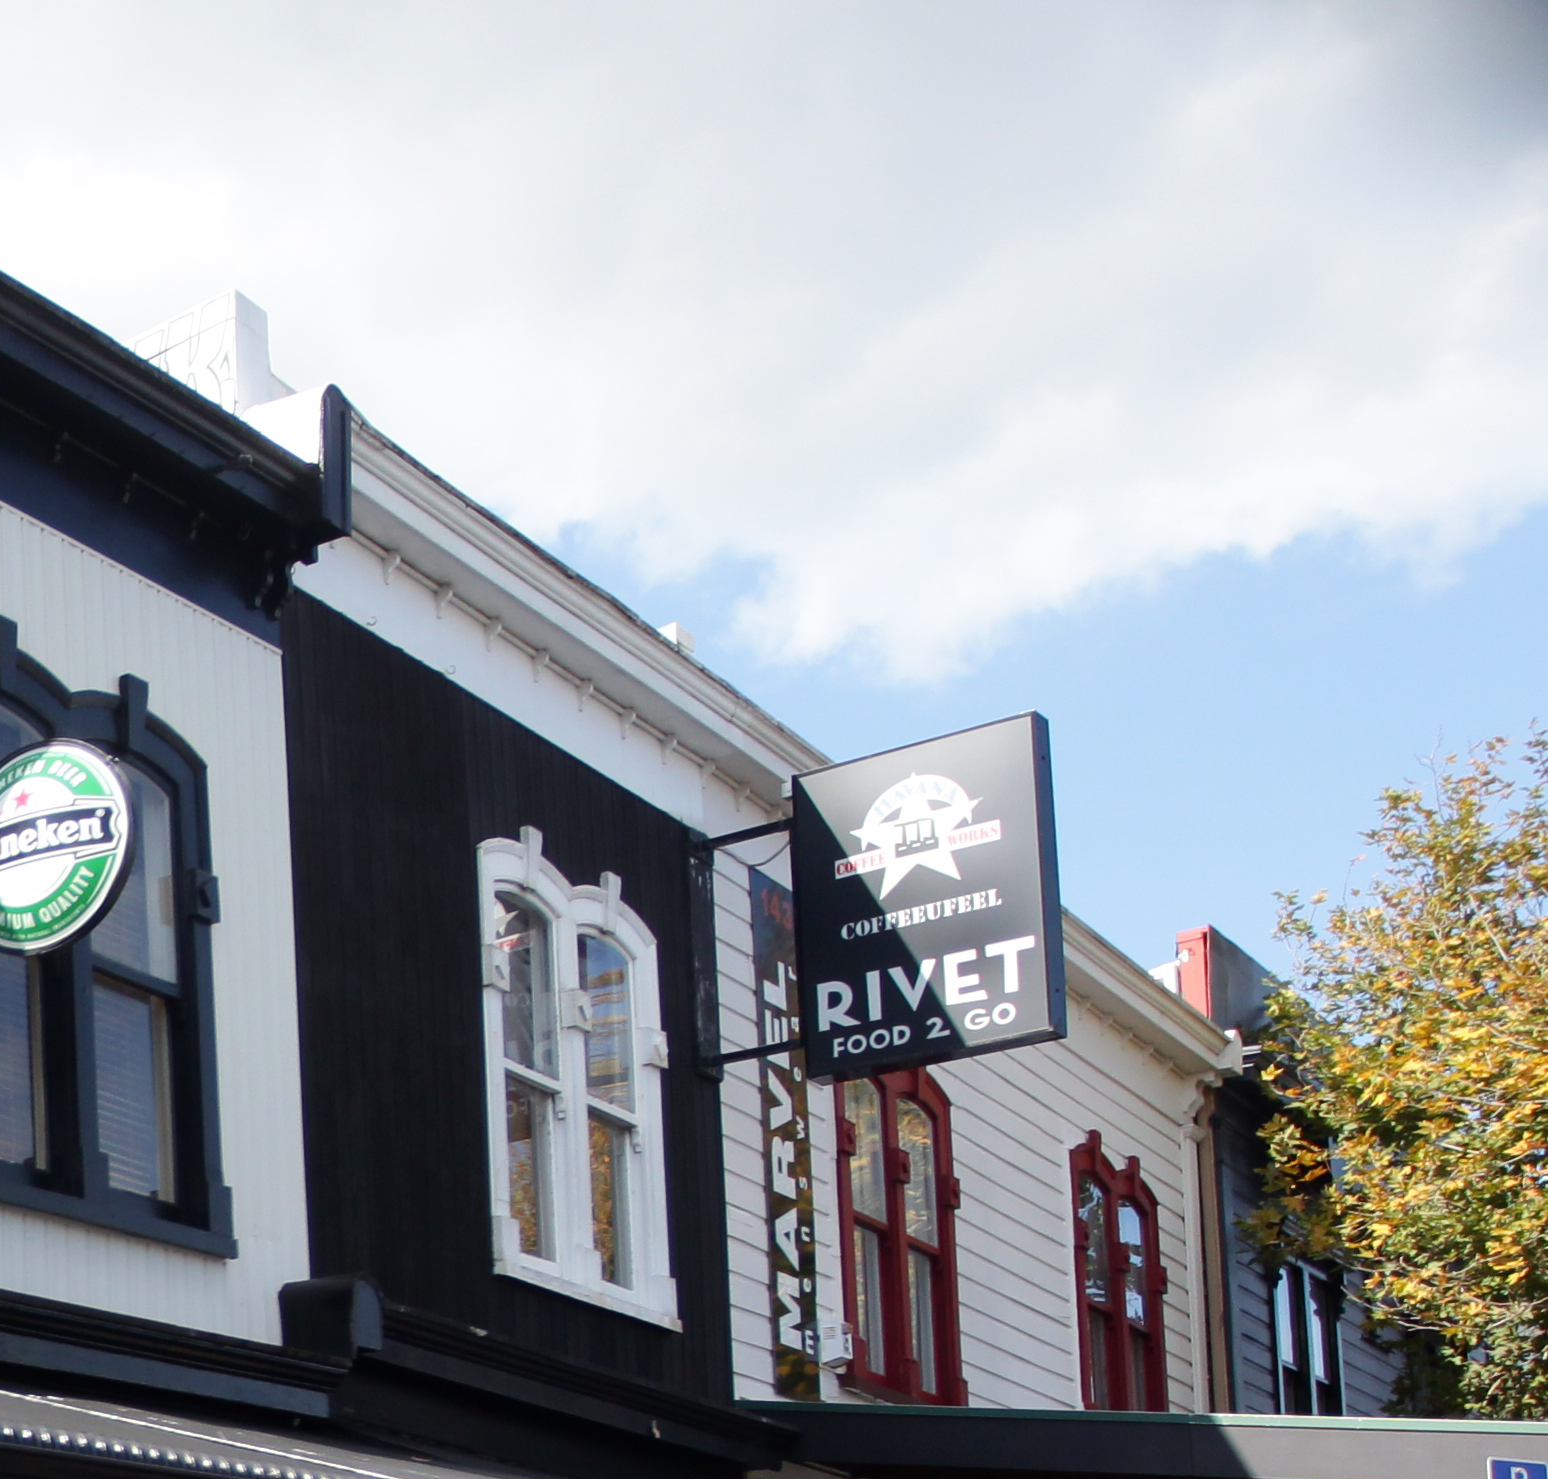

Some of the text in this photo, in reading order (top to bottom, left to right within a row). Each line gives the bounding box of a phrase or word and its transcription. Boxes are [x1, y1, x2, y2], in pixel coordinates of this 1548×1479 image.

[49, 760, 88, 787] BEER
[873, 781, 959, 817] HAVANA
[947, 824, 998, 846] WORKS
[836, 851, 887, 877] COFFEE
[39, 866, 96, 923] QUALITY
[840, 888, 1003, 941] COFFEEUFEEL
[816, 936, 1036, 1033] RIVET
[833, 1002, 1016, 1058] FOOD 2 GO
[762, 961, 804, 1350] MARVEL
[788, 966, 816, 1356] menswear
